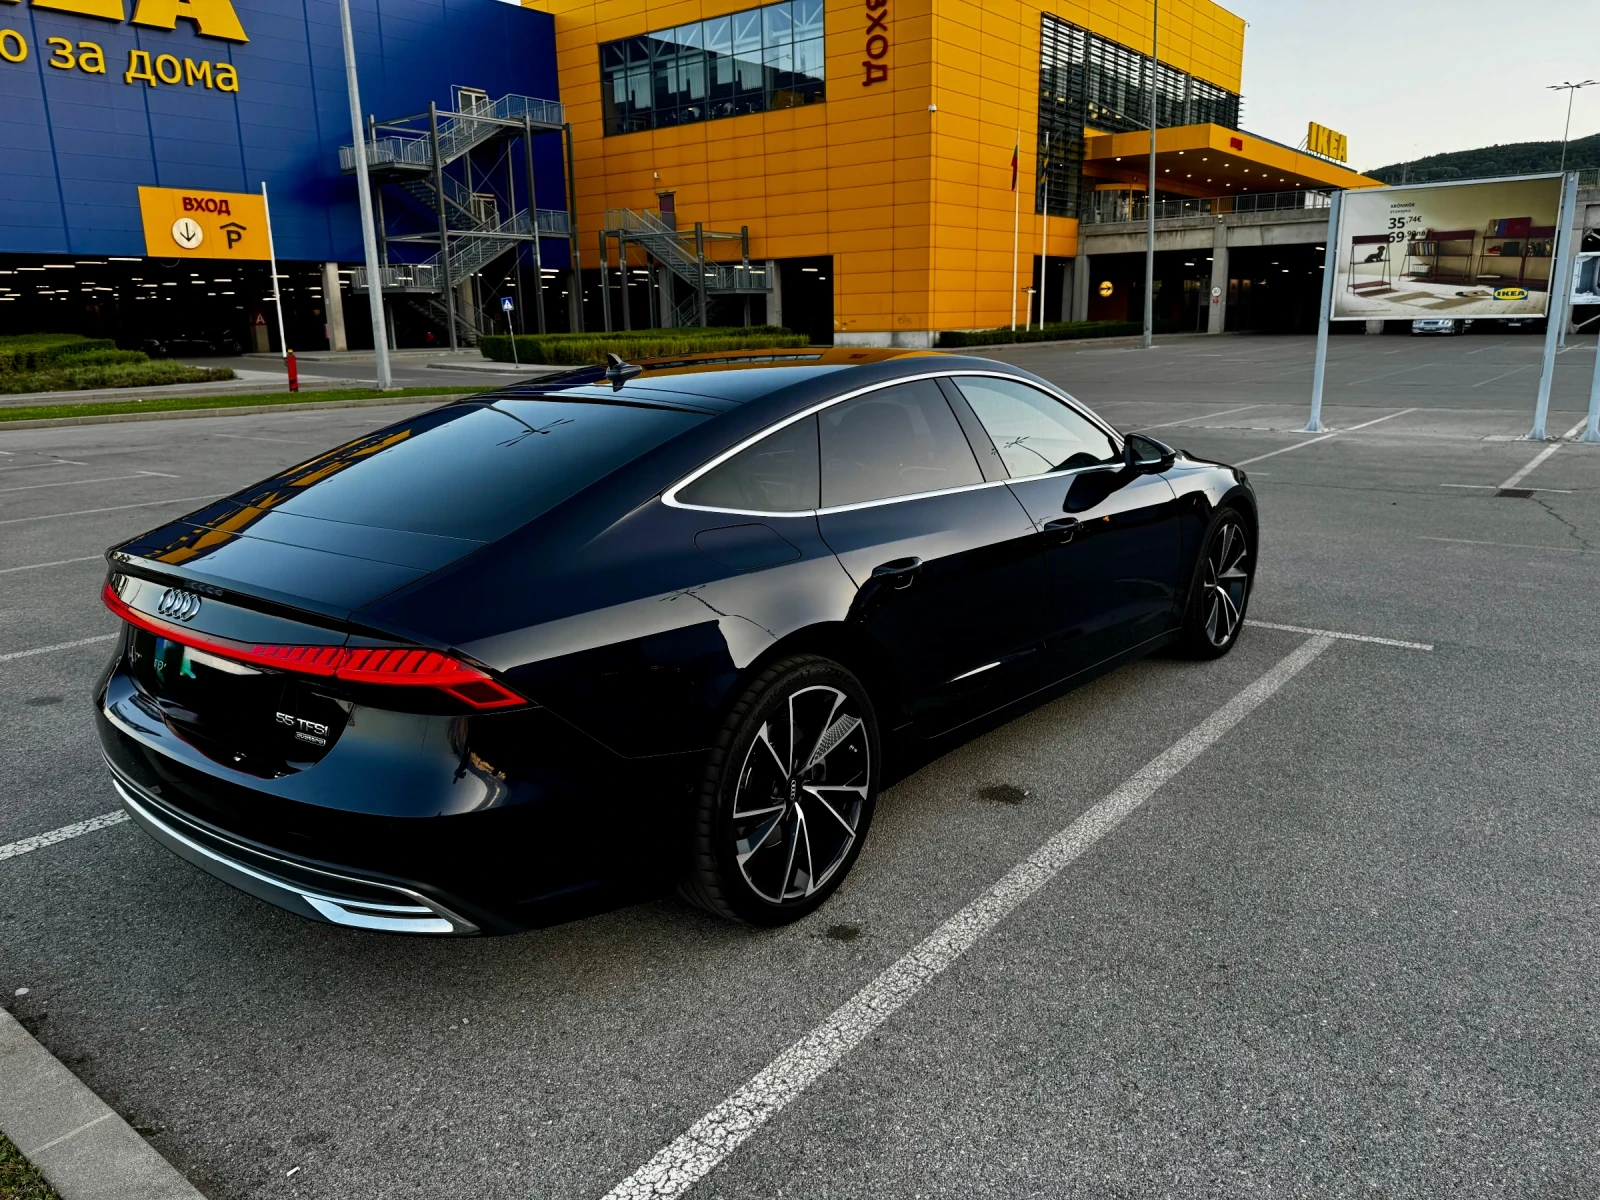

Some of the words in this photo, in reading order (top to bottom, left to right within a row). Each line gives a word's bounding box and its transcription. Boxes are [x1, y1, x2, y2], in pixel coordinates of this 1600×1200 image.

[48, 37, 106, 74] за
[125, 49, 240, 92] дома
[1307, 121, 1347, 163] IKEA
[182, 197, 231, 216] ВХОД
[276, 711, 295, 726] 55
[297, 718, 330, 737] TFSI
